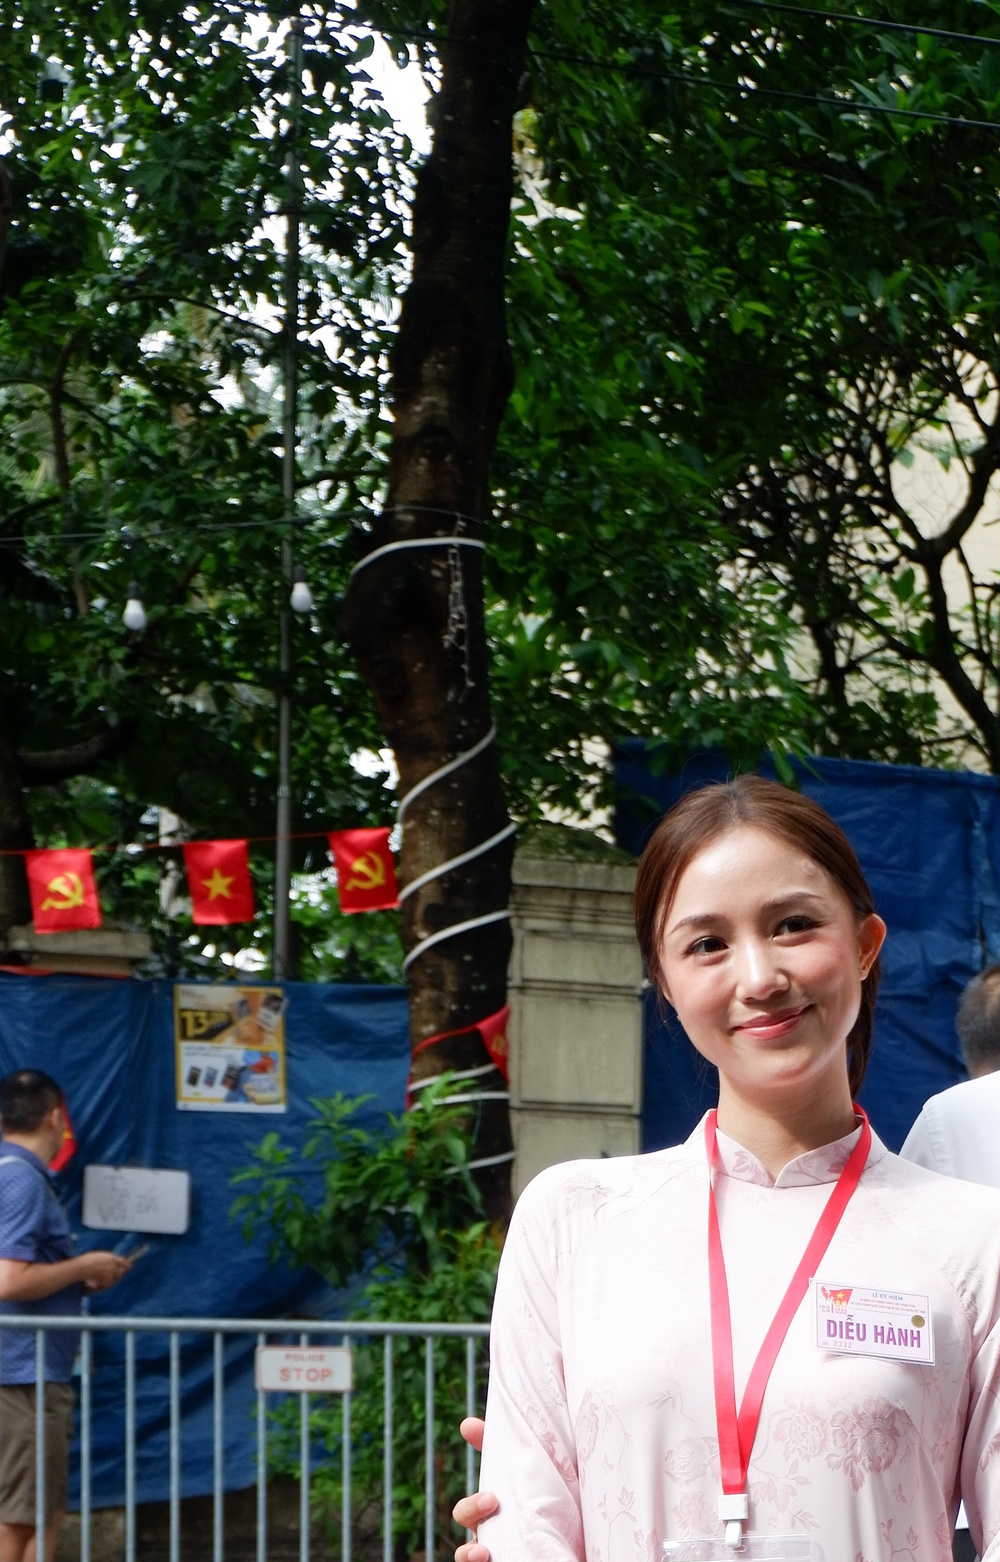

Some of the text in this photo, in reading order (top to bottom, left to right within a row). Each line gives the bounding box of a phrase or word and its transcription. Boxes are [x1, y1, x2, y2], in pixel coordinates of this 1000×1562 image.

[827, 1315, 921, 1348] DIỄU HÀNH
[285, 1353, 326, 1362] POLICE
[280, 1367, 332, 1382] STOP
